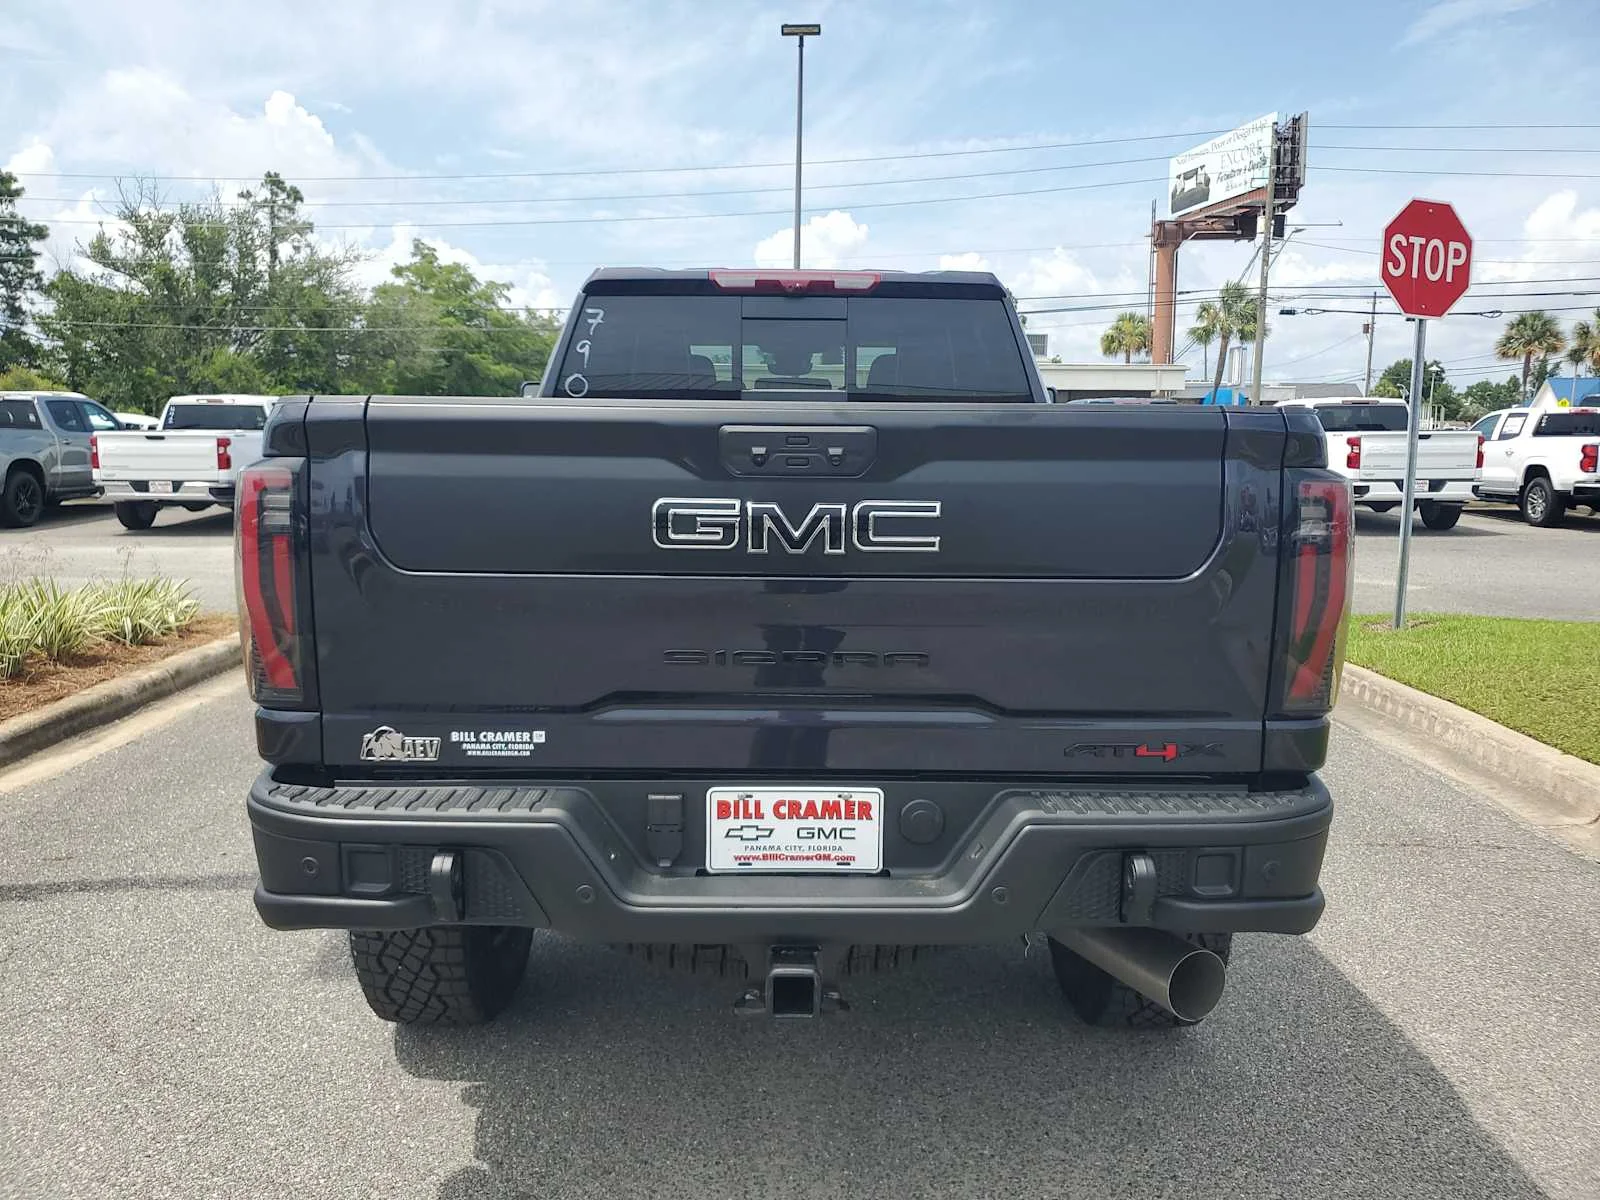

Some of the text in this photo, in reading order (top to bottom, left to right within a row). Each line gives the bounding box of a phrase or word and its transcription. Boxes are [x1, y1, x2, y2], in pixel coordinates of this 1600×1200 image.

[1387, 233, 1467, 282] STOP
[652, 498, 941, 554] GMC
[663, 650, 930, 666] SIERRA
[451, 731, 476, 742] BILL
[479, 731, 531, 742] CRAMER
[402, 739, 439, 759] AEV
[717, 800, 873, 820] BILL CRAMER
[796, 827, 856, 840] GMC
[784, 845, 805, 853] CITY,
[733, 853, 856, 863] www.BillCramerGM.com
